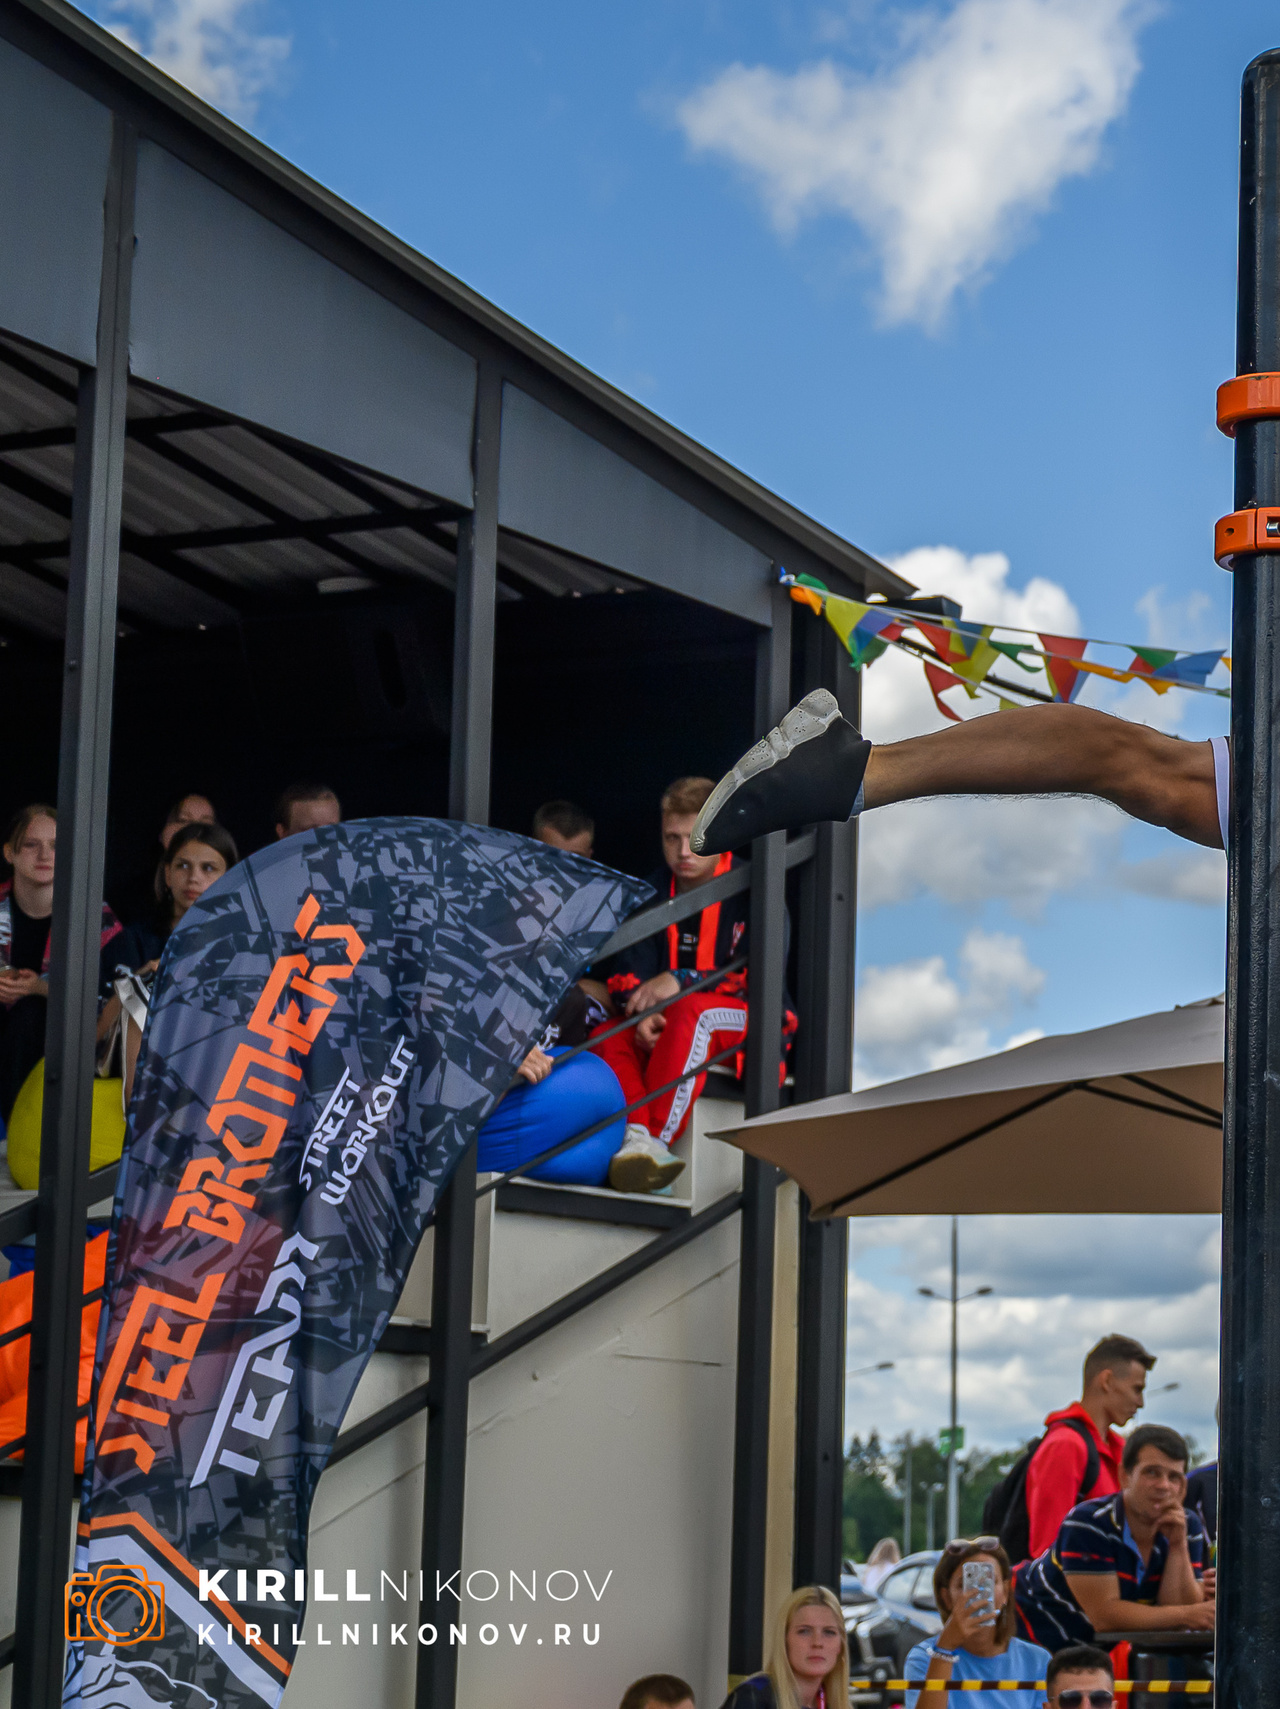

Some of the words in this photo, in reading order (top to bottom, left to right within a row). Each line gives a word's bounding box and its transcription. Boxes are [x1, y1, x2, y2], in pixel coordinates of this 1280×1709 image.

[95, 1272, 226, 1476] STEEL
[163, 892, 367, 1244] BROTHERS
[299, 1066, 361, 1191] STREET
[320, 1034, 415, 1205] WORKOUT
[189, 1231, 320, 1489] TEAM
